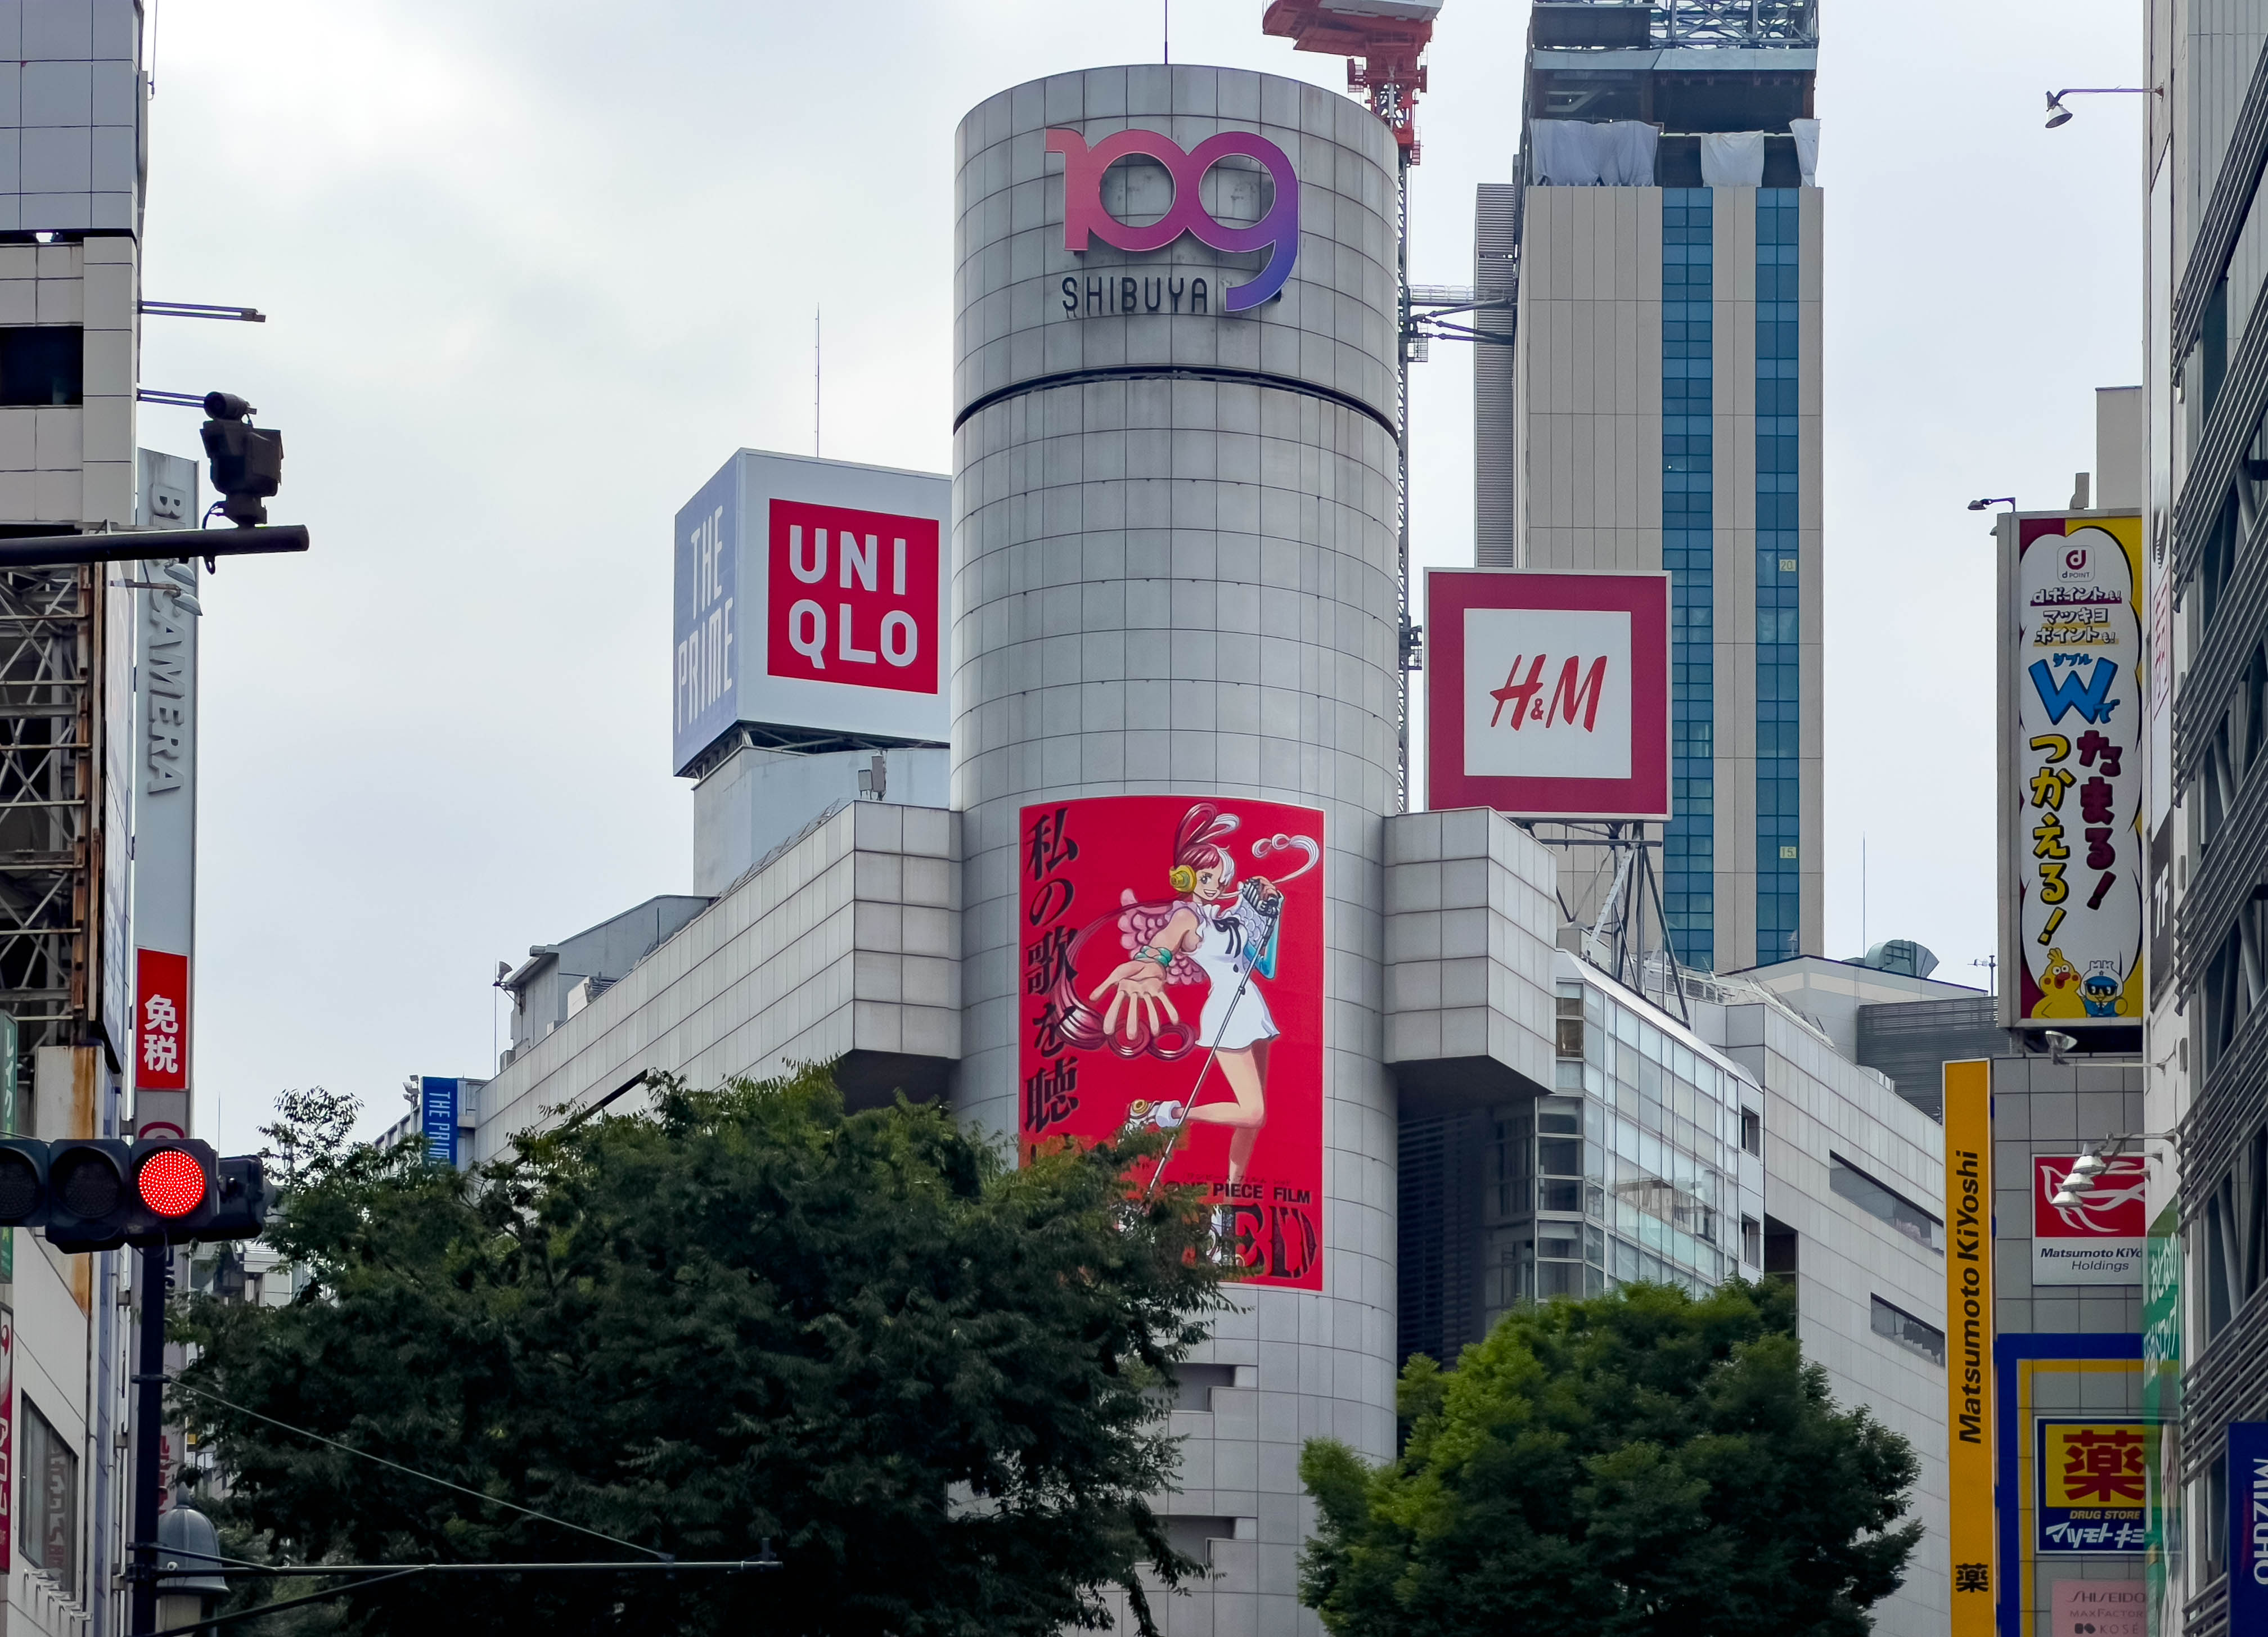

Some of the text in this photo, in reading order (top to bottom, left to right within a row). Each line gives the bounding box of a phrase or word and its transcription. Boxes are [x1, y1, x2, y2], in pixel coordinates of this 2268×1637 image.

[1045, 127, 1300, 312] 109
[1062, 276, 1208, 315] SHIBUYA
[691, 505, 723, 620] THE
[789, 524, 906, 596] UNI
[677, 597, 734, 734] PRIME
[789, 598, 918, 670] QLO
[2053, 652, 2093, 668] ダブル
[1490, 653, 1608, 733] H&M
[2155, 862, 2169, 939] 7F
[1025, 806, 1079, 1165] 私の歌を聴
[144, 993, 179, 1074] 免税
[4, 1028, 14, 1118] レイク
[429, 1091, 451, 1118] THE
[1213, 1183, 1263, 1199] PIECE
[1274, 1187, 1311, 1204] FILM
[2040, 1247, 2113, 1258] Matsumoto
[2071, 1260, 2129, 1272] Holdings
[1956, 1150, 1982, 1445] Matsumoto KiYoshi
[2063, 1429, 2145, 1502] 薬
[2069, 1510, 2141, 1519] DRUG STORE
[1955, 1562, 1989, 1593] 薬
